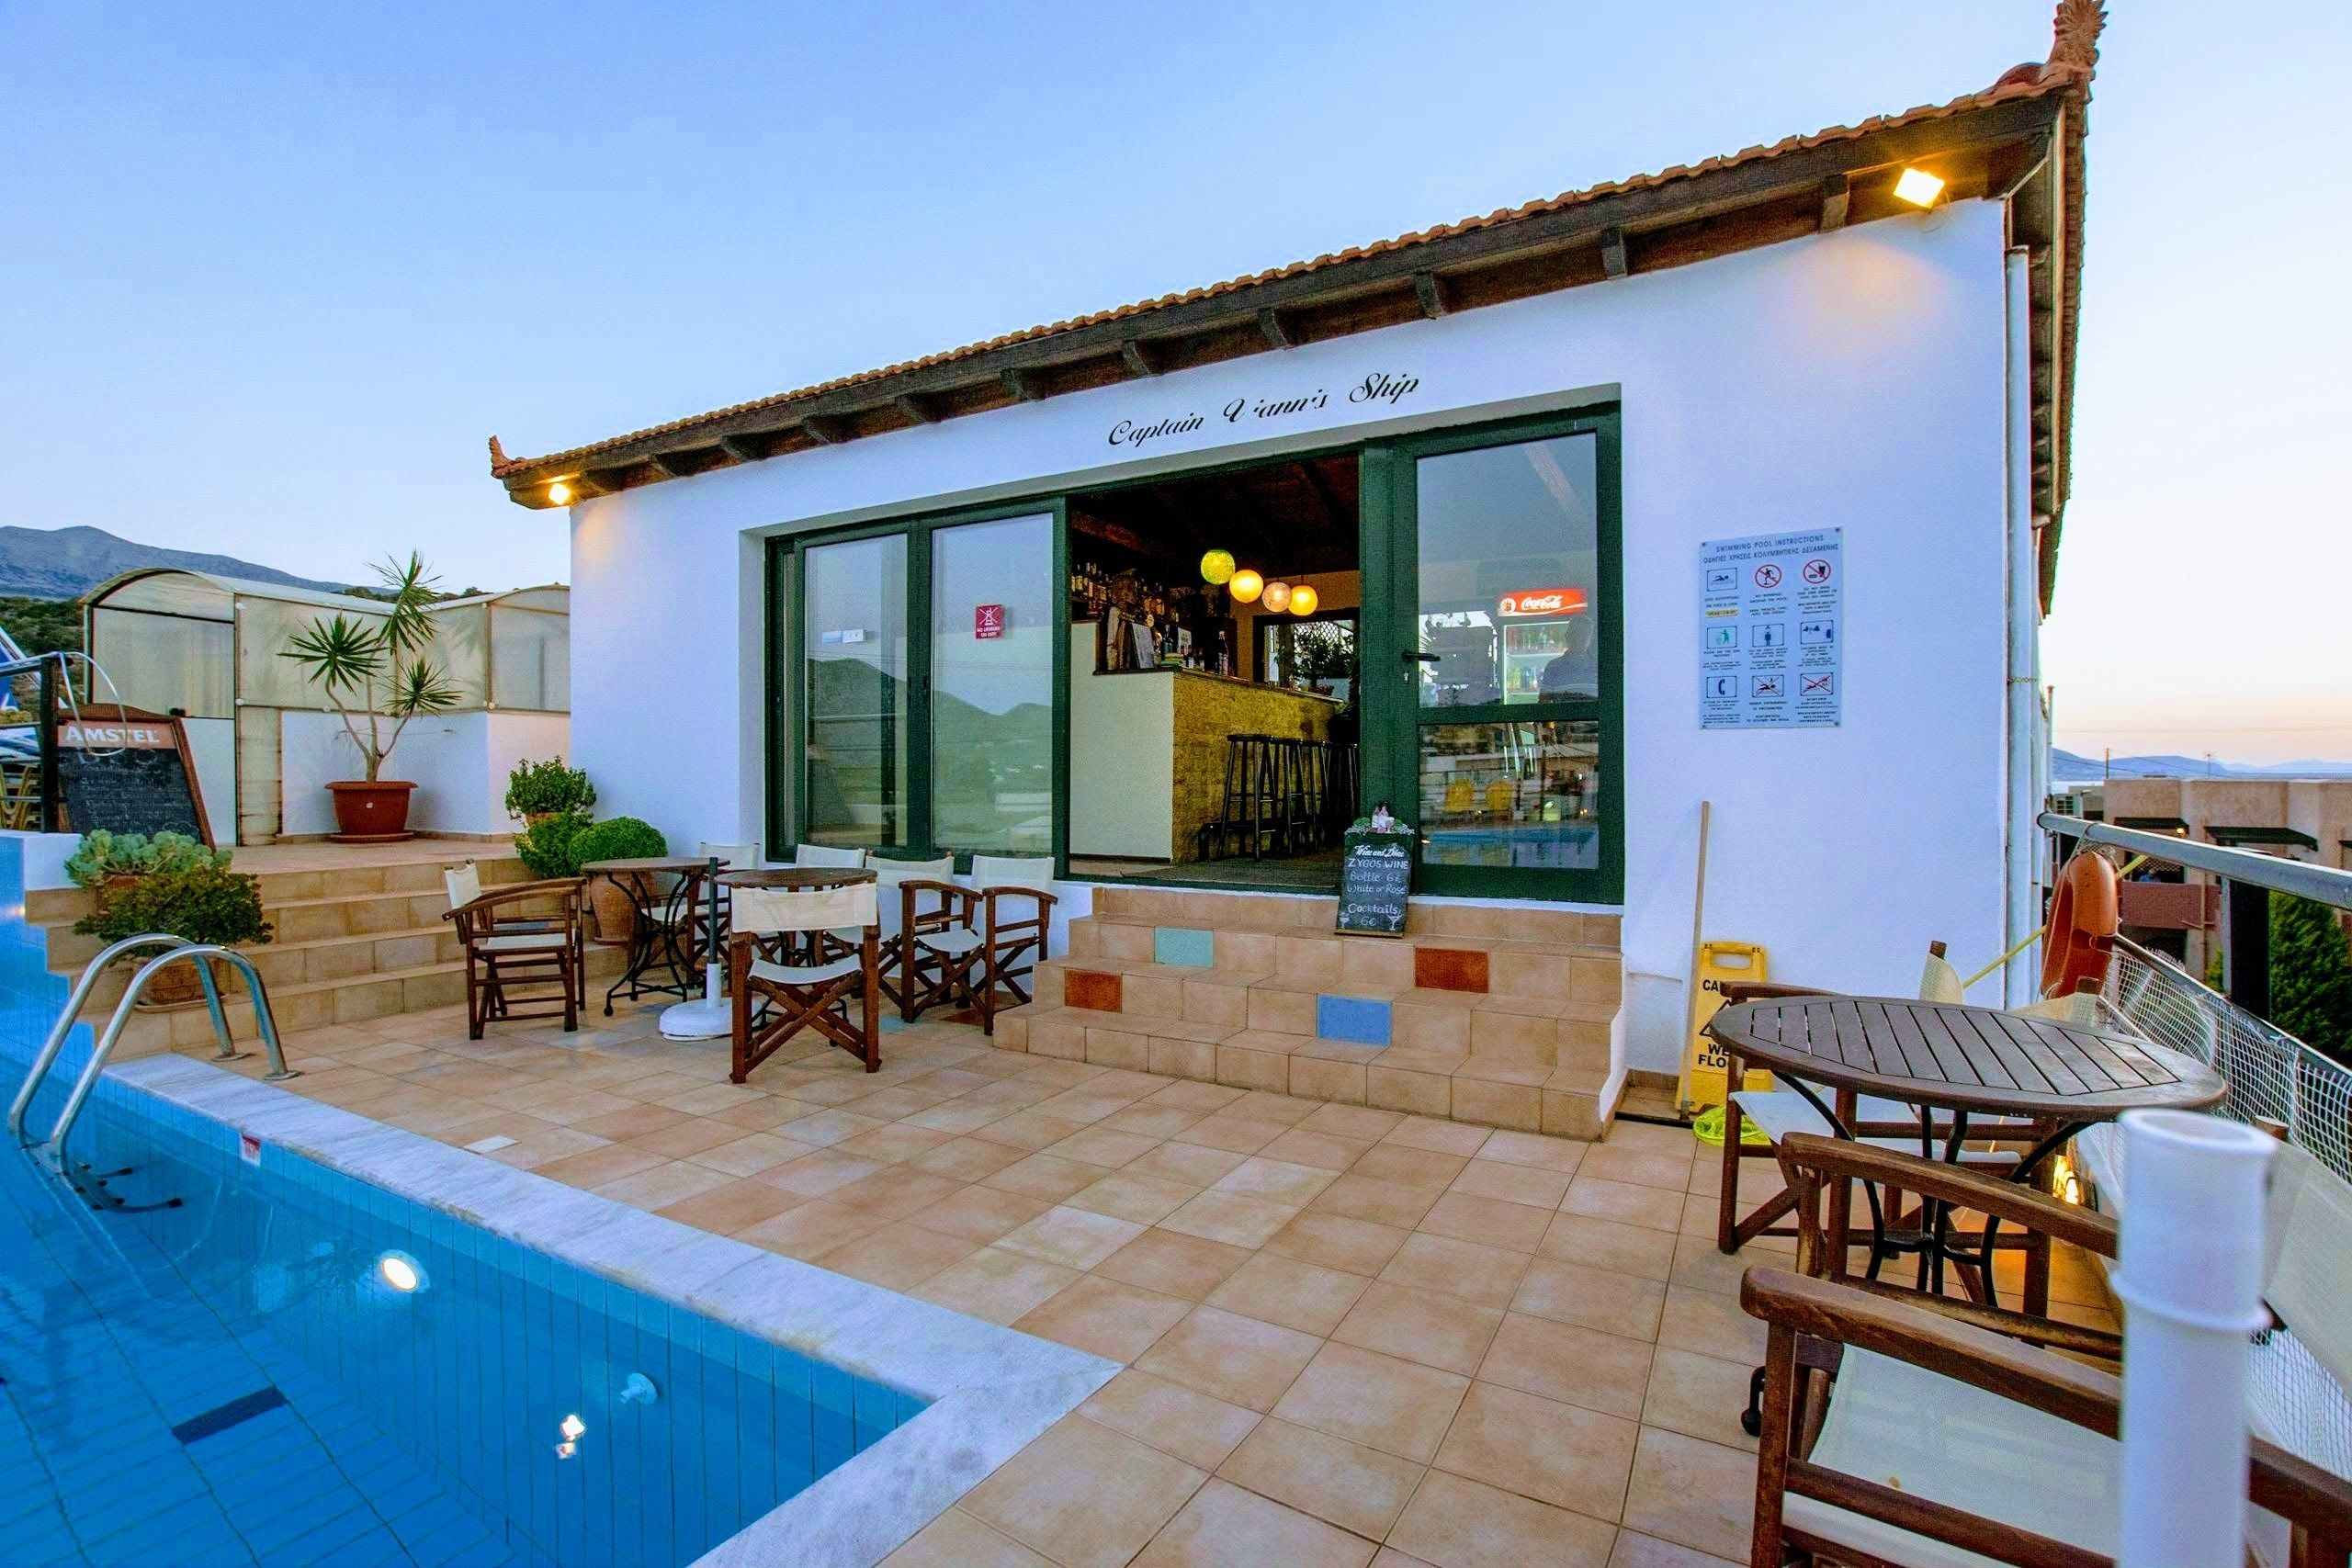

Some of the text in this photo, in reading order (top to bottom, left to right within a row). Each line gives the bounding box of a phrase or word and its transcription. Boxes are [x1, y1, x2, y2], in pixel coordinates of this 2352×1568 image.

[1108, 412, 1204, 447] Captain
[1349, 372, 1419, 404] Ship
[1716, 535, 1824, 553] SWIMMING POOL INSTRUCTIONS
[1521, 594, 1564, 611] Coca-Cola
[65, 724, 160, 743] AMSTEL
[1373, 848, 1386, 856] and
[1385, 860, 1408, 870] WINE
[1350, 871, 1380, 882] Bottle
[1347, 884, 1374, 893] White
[1347, 903, 1398, 914] Cocktails
[1708, 1043, 1730, 1056] WE
[1698, 1054, 1726, 1068] FLO
